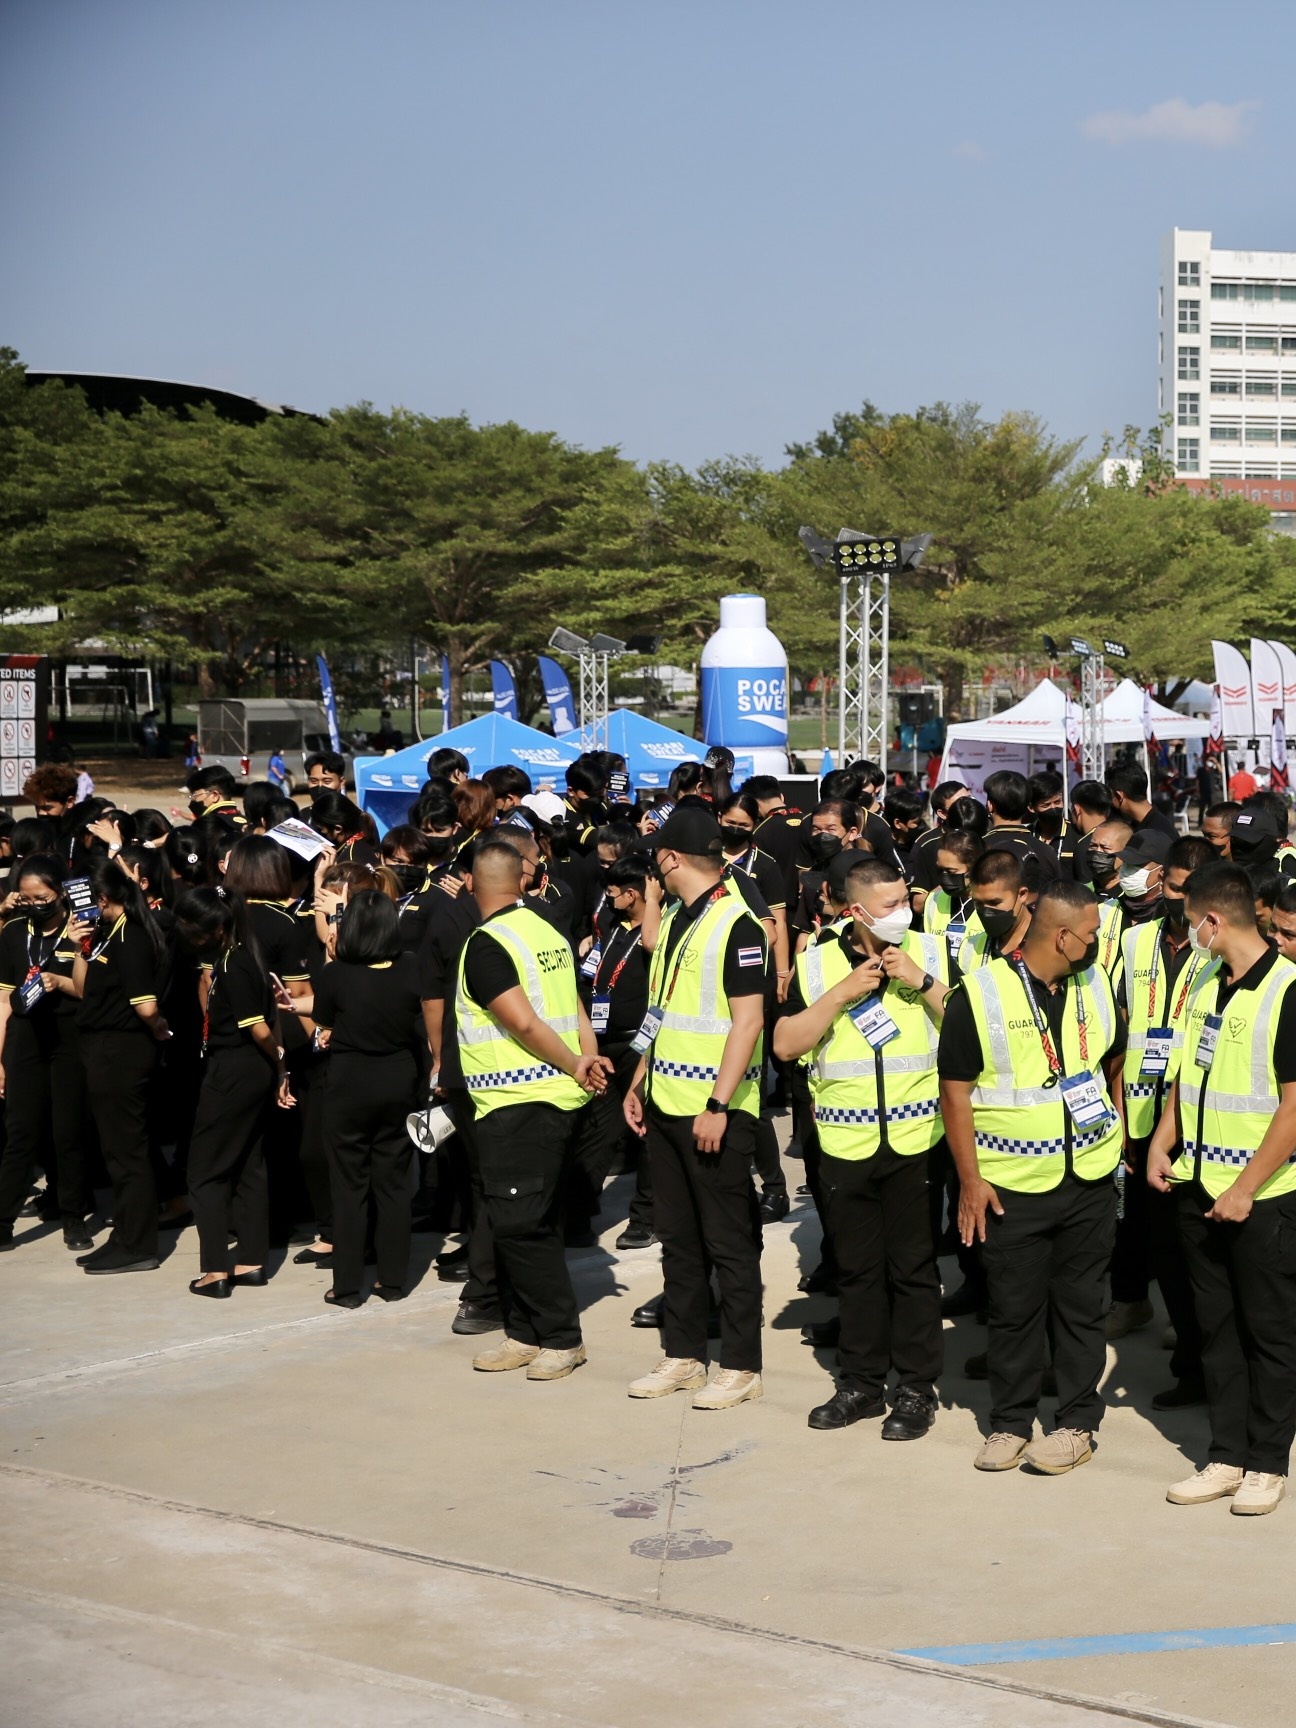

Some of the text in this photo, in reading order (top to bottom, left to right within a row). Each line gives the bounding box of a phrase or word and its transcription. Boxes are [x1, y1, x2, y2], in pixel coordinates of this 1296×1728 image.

[0, 668, 36, 680] ED ITEMS
[874, 1009, 885, 1019] FA
[1008, 1018, 1038, 1030] GUAR
[1020, 1030, 1034, 1039] 797
[1085, 1086, 1097, 1096] FA
